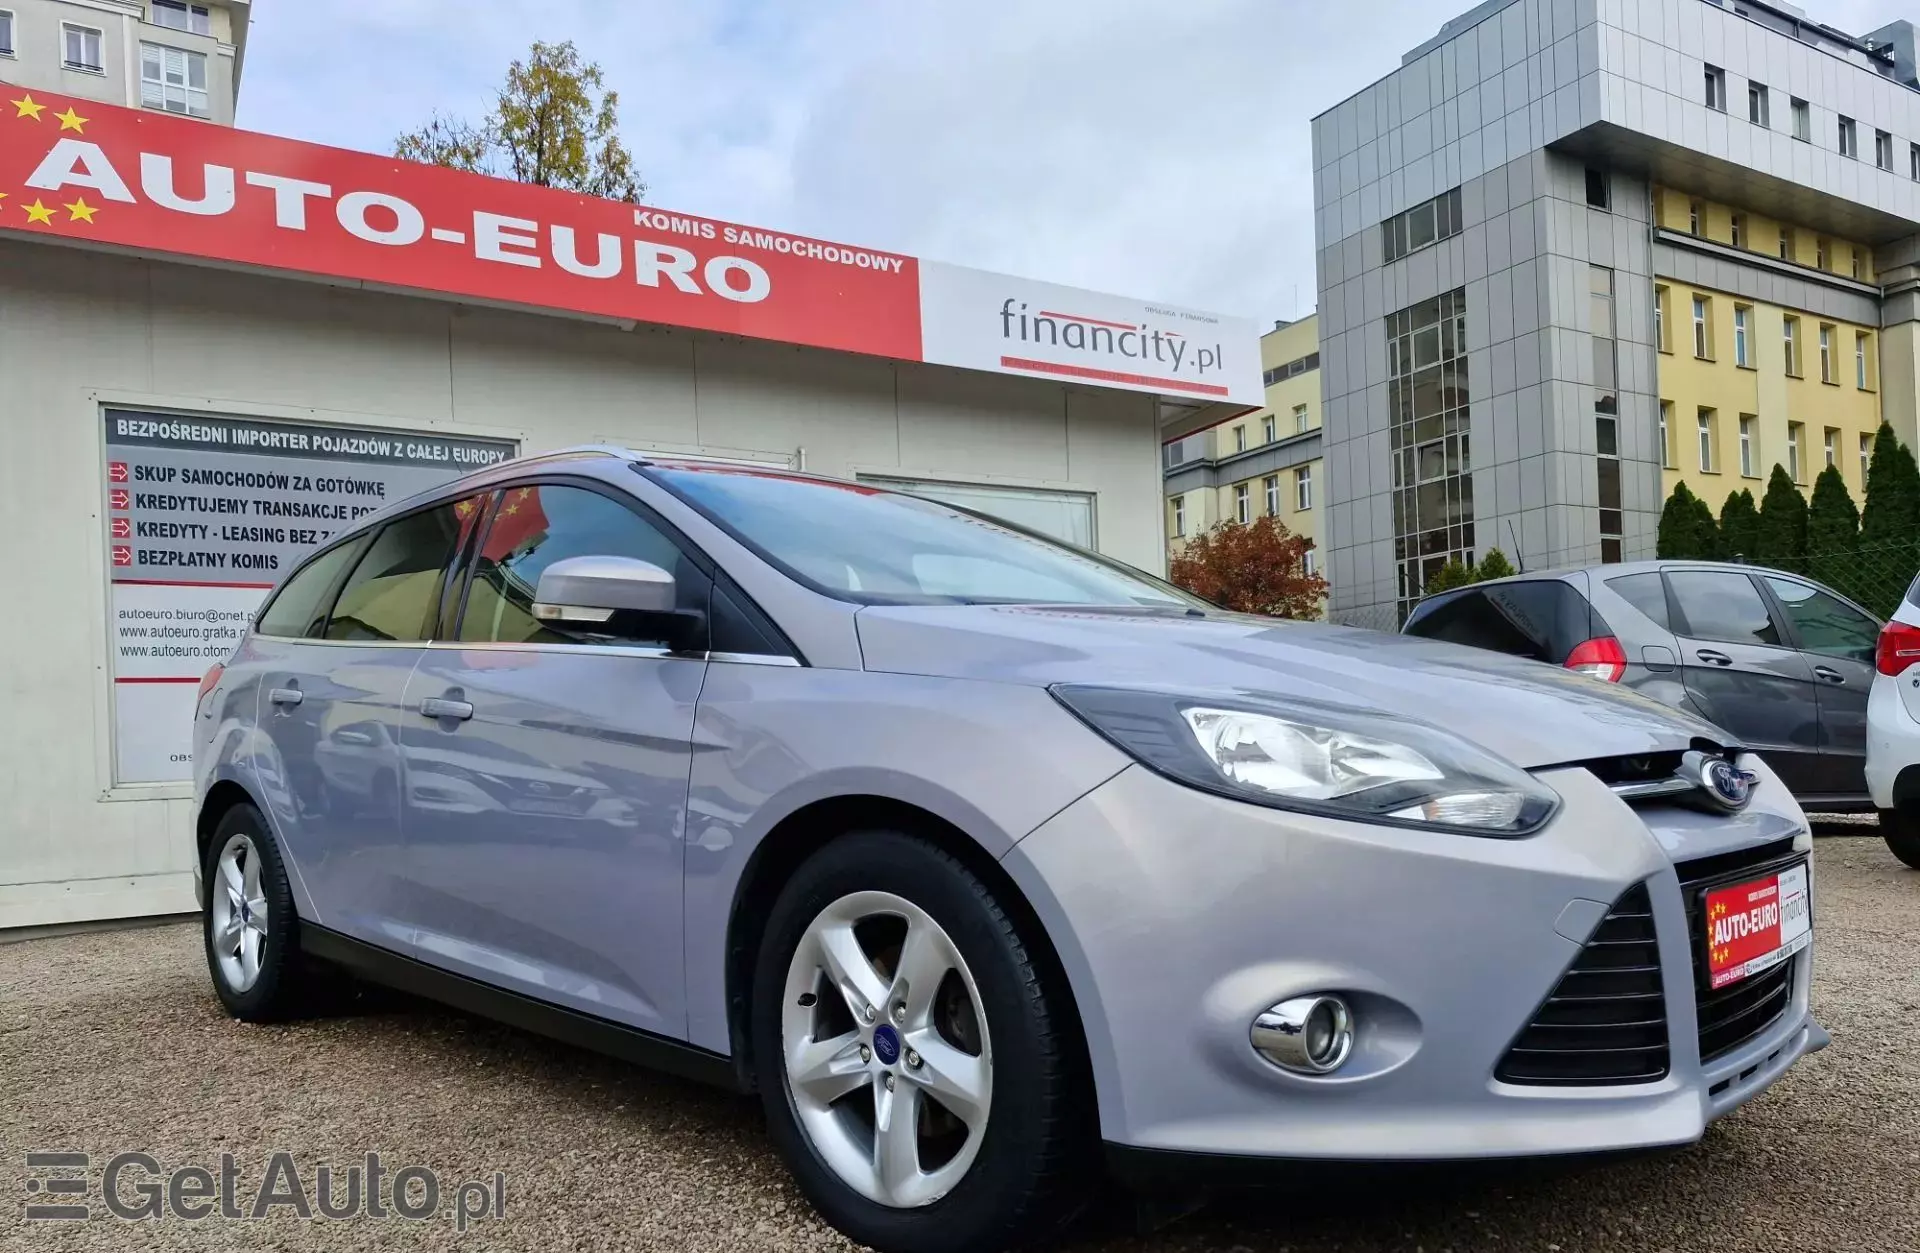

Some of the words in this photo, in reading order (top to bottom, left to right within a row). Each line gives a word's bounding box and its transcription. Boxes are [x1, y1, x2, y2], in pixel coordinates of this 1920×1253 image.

[24, 137, 771, 303] AUTO-EURO
[633, 209, 716, 240] KOMIS
[723, 227, 904, 273] SAMOCHODOWY
[1000, 298, 1222, 374] financity.pl
[117, 419, 228, 444] BEZPOŚREDNI
[232, 428, 309, 450] IMPORTER
[313, 436, 390, 457] POJAZDÓW
[394, 443, 403, 457] Z
[407, 444, 449, 461] CAŁEJ
[453, 447, 505, 465] EUROPY
[135, 465, 177, 483] SKUP
[181, 468, 289, 490] SAMOCHODÓW
[293, 476, 312, 491] ZA
[316, 477, 385, 499] GOTÓWKĘ
[136, 493, 248, 514] KREDYTUJEMY
[253, 500, 347, 519] TRANSAKCJE
[137, 521, 208, 539] KREDYTY
[222, 526, 285, 543] LEASING
[290, 529, 317, 544] BEZ
[138, 549, 227, 568] BEZPŁATNY
[231, 554, 279, 569] KOMIS
[1714, 902, 1778, 947] AUTO-EURO
